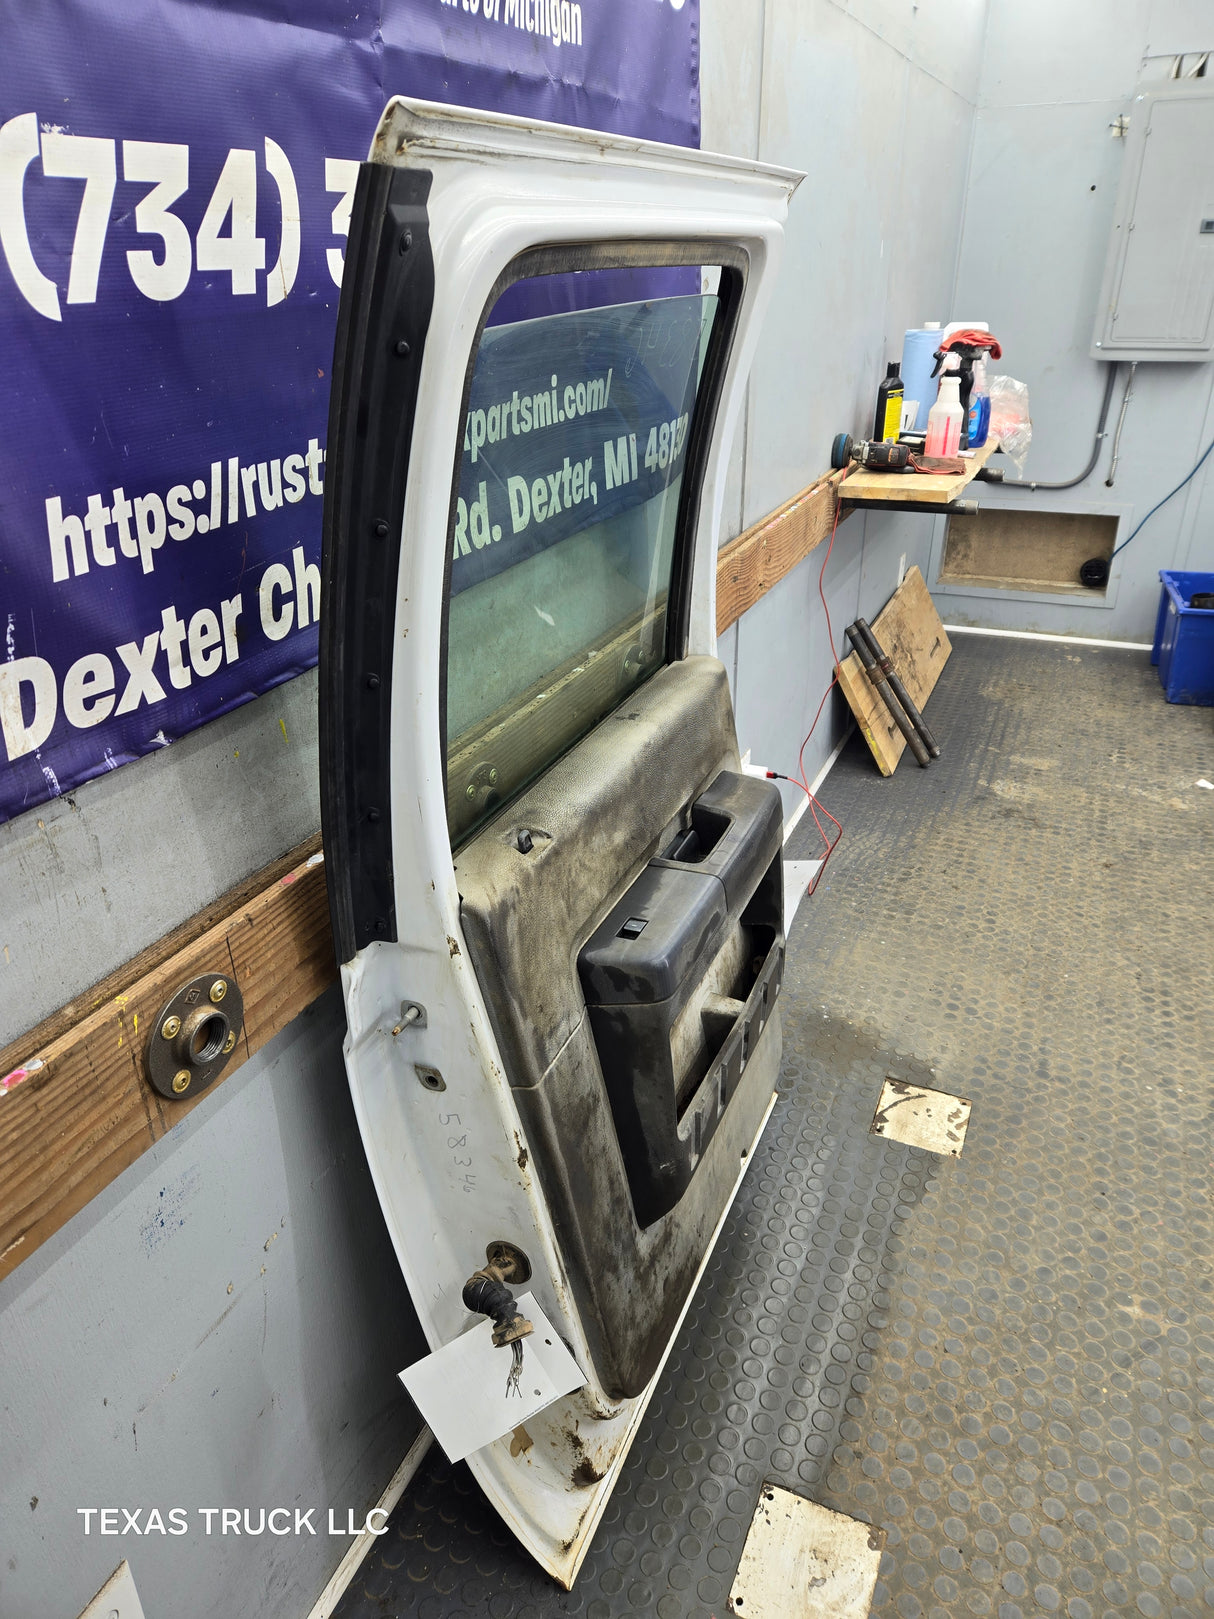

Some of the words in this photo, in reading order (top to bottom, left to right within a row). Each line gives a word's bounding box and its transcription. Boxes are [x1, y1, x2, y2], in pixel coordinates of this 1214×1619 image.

[0, 112, 301, 322] (734)
[0, 593, 243, 762] Dexter
[452, 481, 502, 560] Rd.
[507, 457, 598, 534] Dexter,
[603, 433, 638, 490] MI
[45, 438, 327, 583] https://rust
